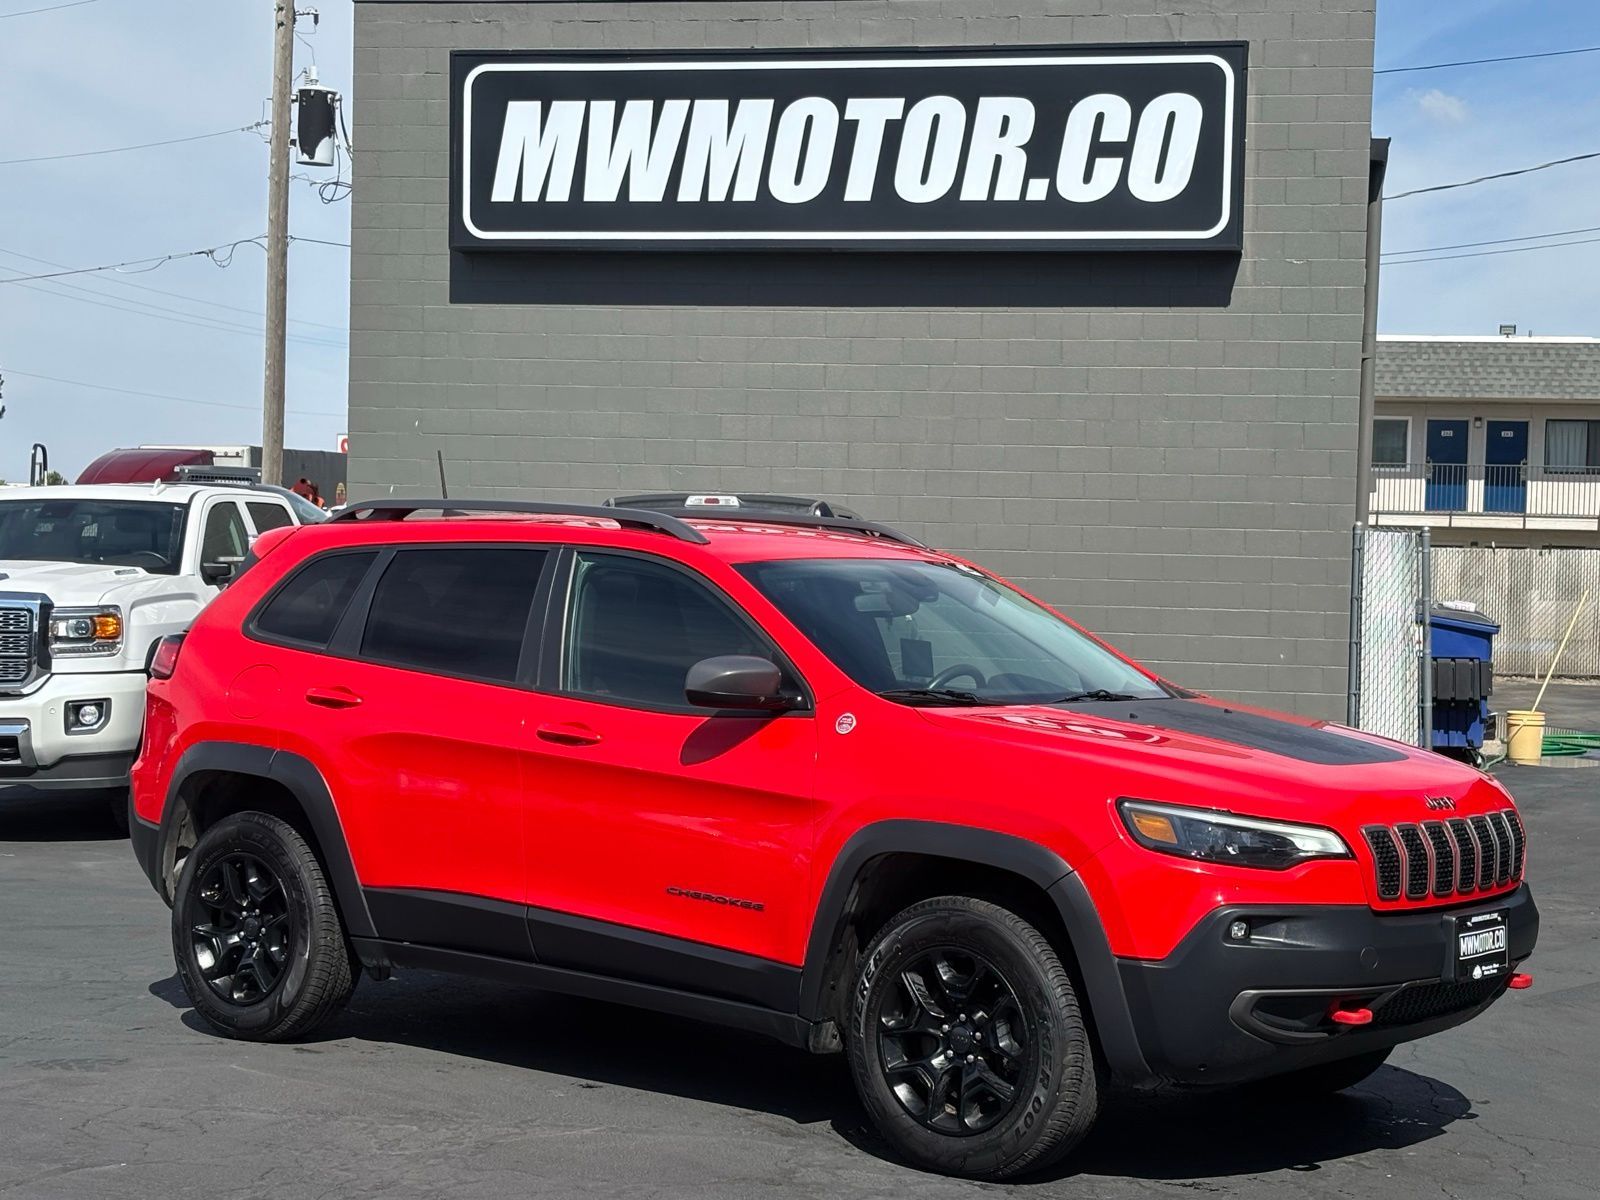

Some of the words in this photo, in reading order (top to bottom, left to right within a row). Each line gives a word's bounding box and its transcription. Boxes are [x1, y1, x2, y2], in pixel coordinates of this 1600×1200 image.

[490, 92, 1204, 205] MWMOTOR.CO
[666, 886, 765, 911] CHEROKEE
[1460, 929, 1504, 956] MWMOTOR.CO
